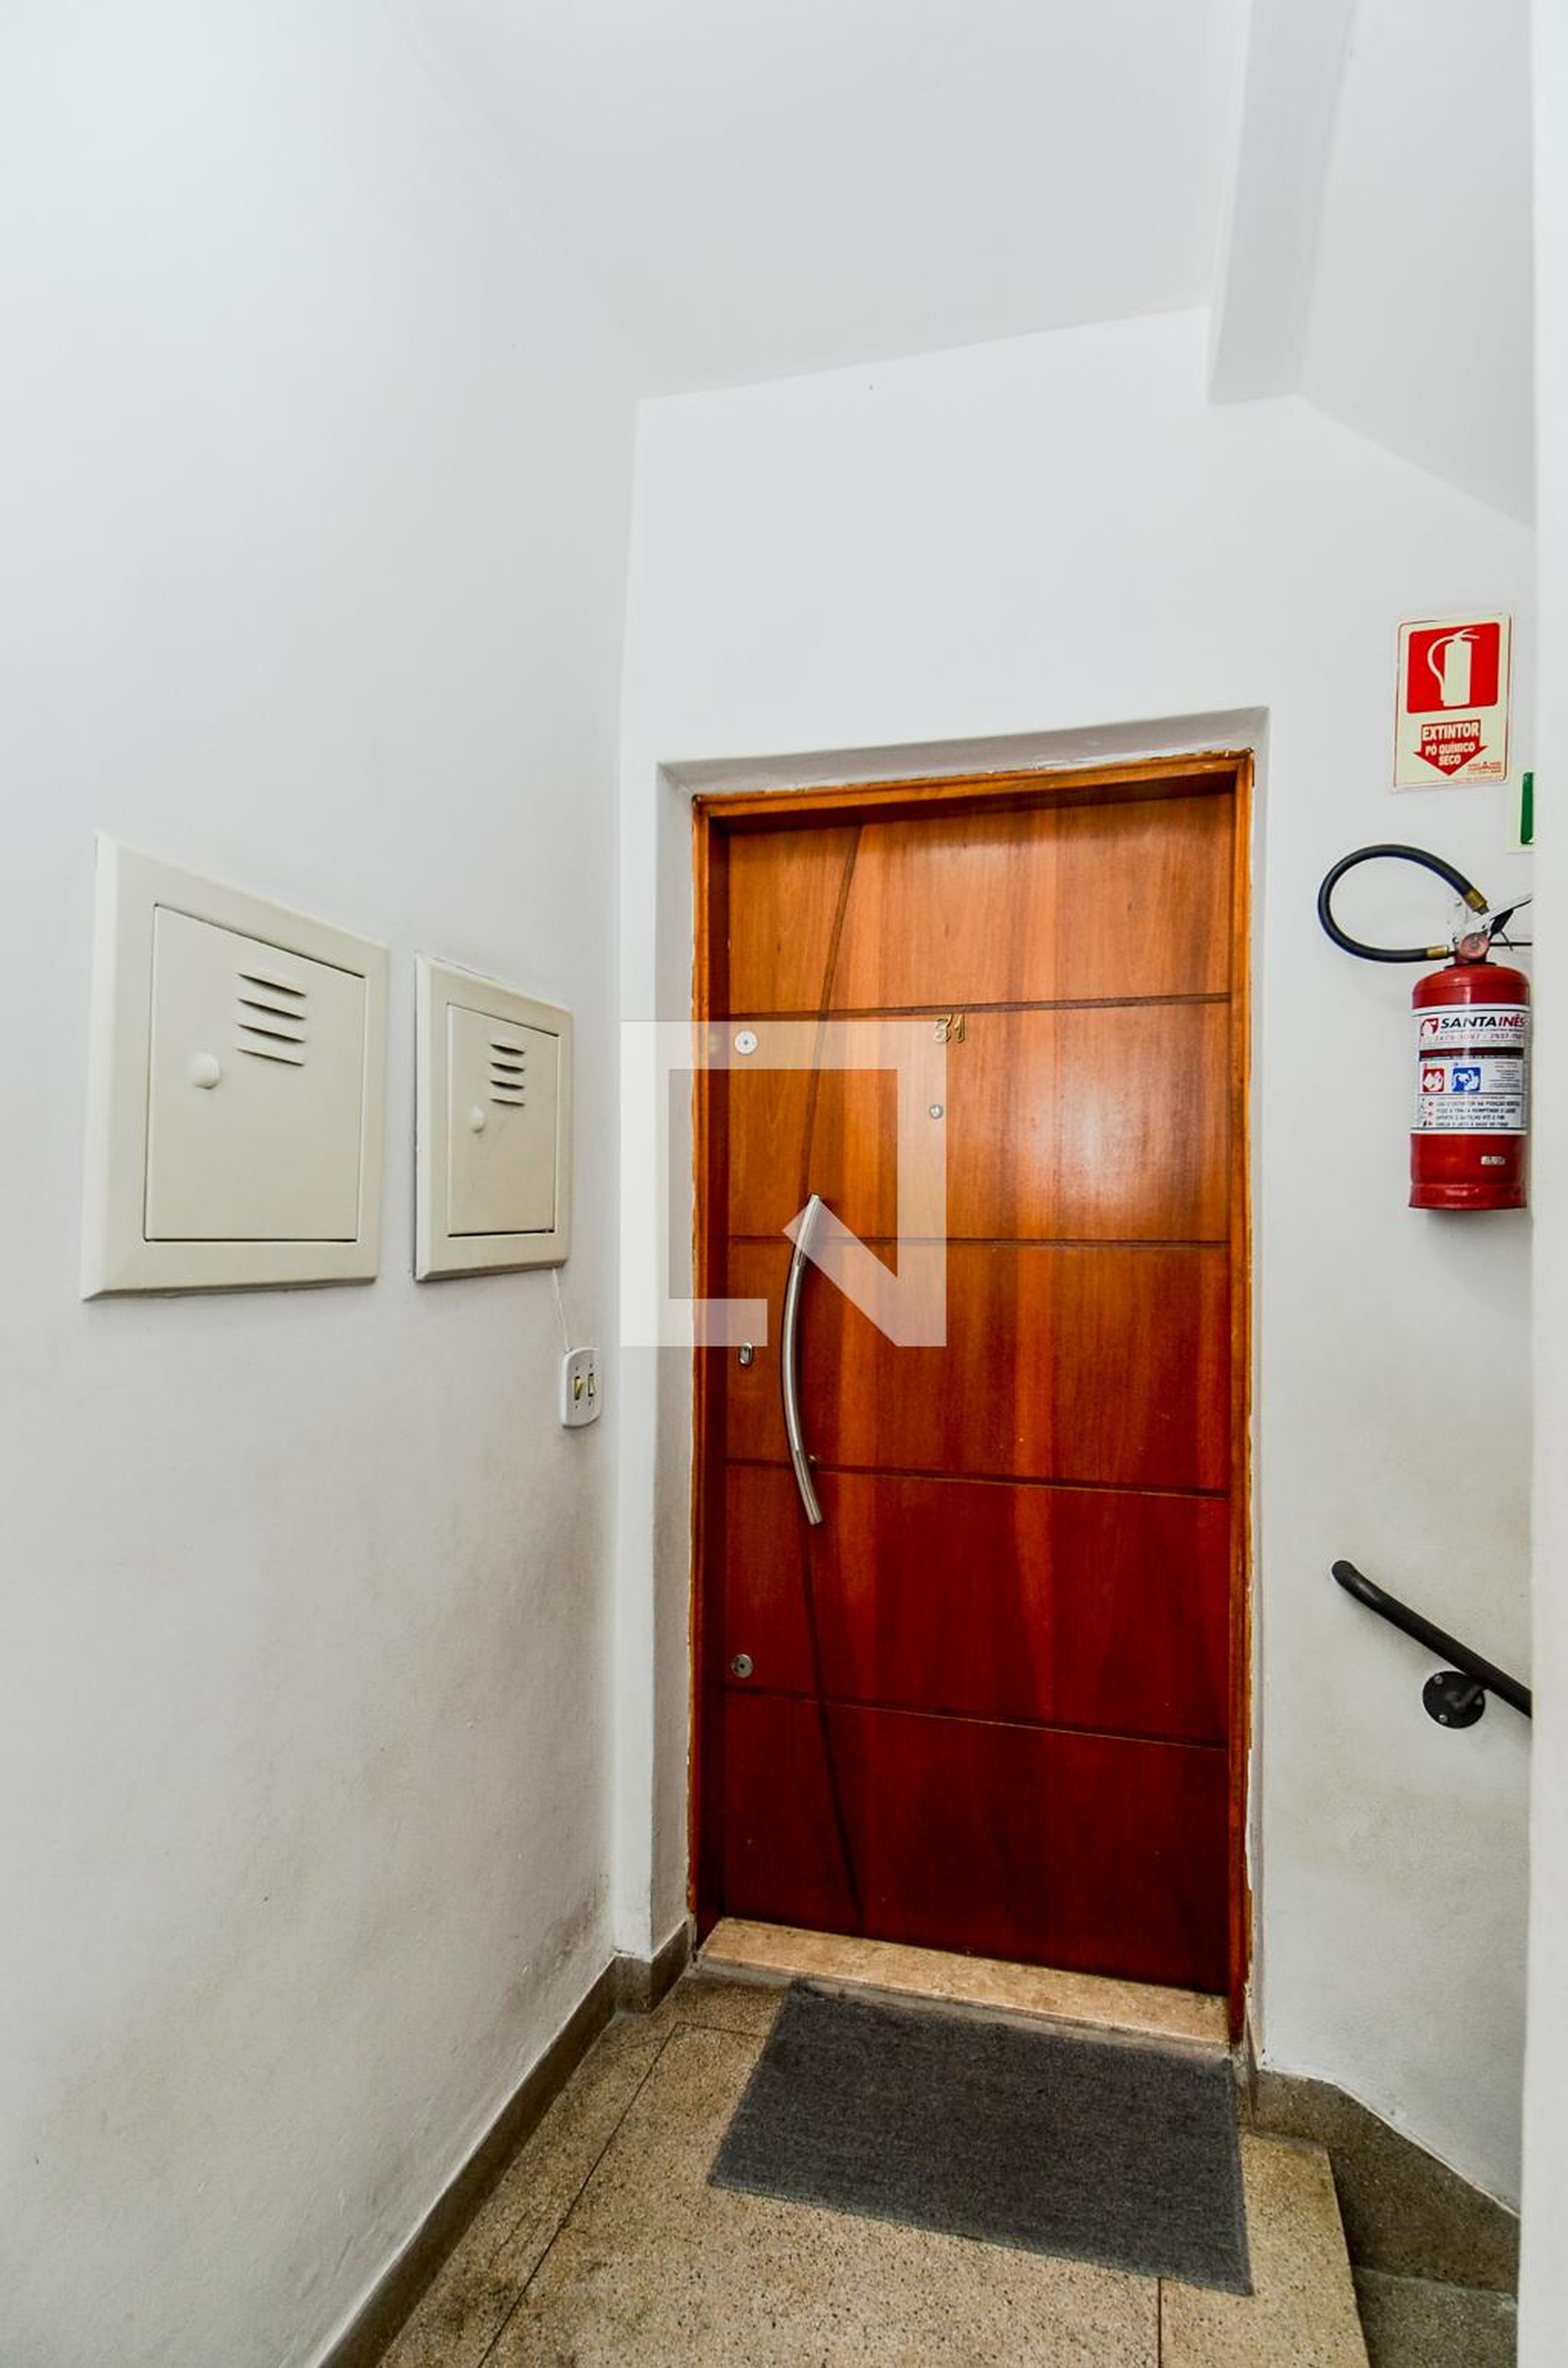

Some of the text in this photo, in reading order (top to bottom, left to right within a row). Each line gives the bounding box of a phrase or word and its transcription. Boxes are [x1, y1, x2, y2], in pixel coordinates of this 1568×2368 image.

[1422, 722, 1479, 740] EXTINTOR
[1425, 743, 1437, 756] PÓ
[1438, 754, 1461, 766] SECO
